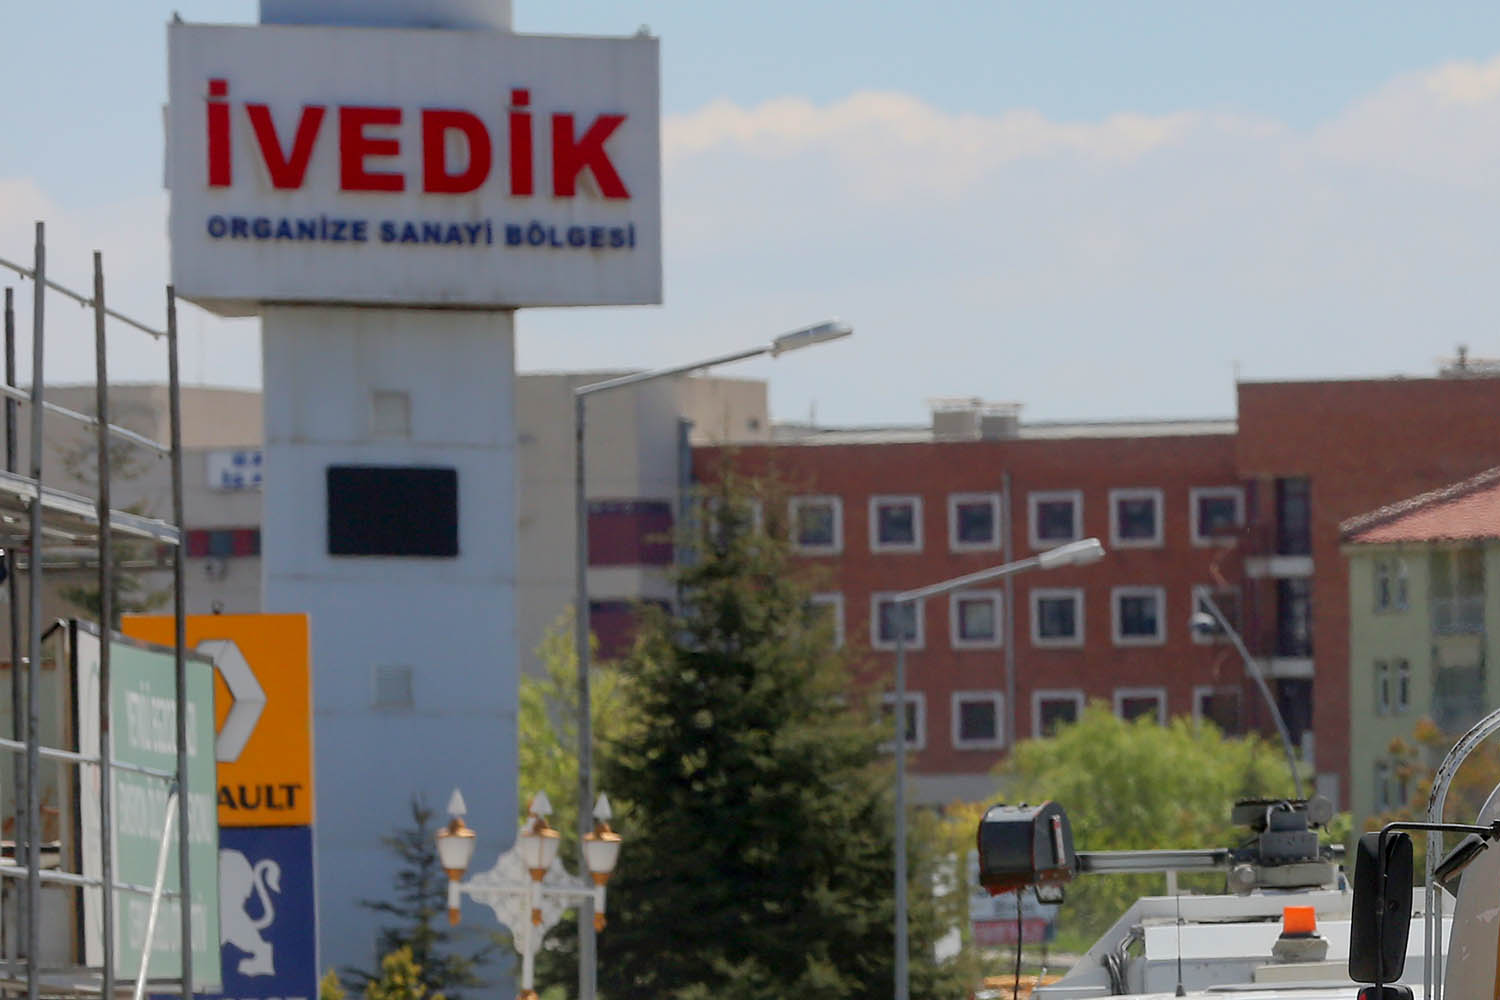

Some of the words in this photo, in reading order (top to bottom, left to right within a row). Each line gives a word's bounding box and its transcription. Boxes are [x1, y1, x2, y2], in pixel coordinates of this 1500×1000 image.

[207, 78, 632, 200] İVEDİK
[207, 214, 368, 241] ORGANİZE
[379, 219, 493, 245] SANAYİ
[504, 219, 636, 248] BÖLGESİ
